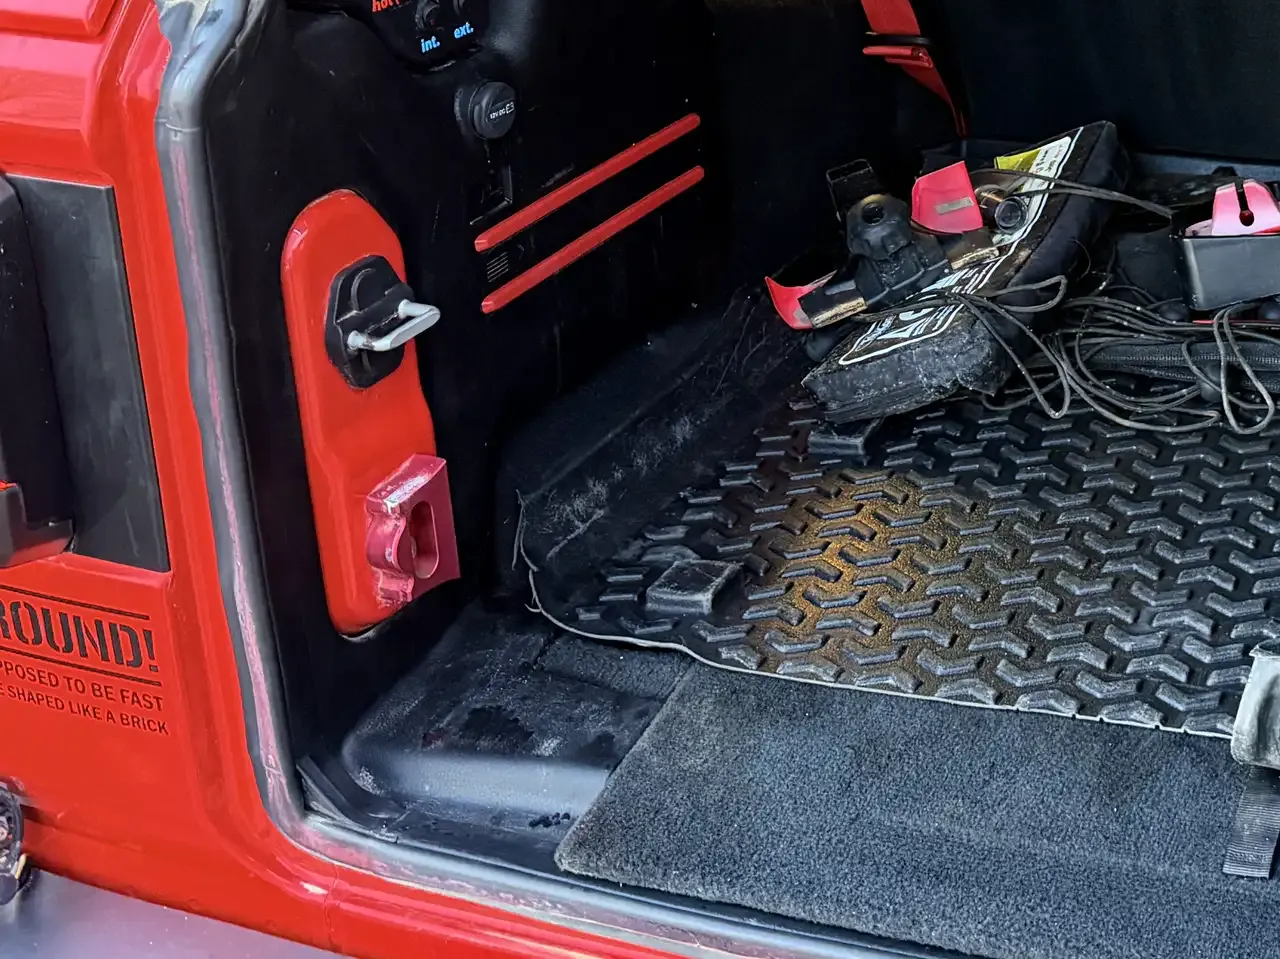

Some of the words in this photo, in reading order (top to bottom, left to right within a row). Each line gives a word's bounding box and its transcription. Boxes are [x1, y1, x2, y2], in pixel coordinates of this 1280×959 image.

[453, 21, 474, 39] ext.
[420, 35, 441, 53] int.
[63, 675, 86, 694] TO
[91, 682, 117, 702] BE
[119, 689, 164, 712] FAST
[7, 685, 65, 711] SHAPED
[68, 700, 103, 721] LIKE
[106, 709, 117, 724] A
[119, 713, 170, 736] BRICK
